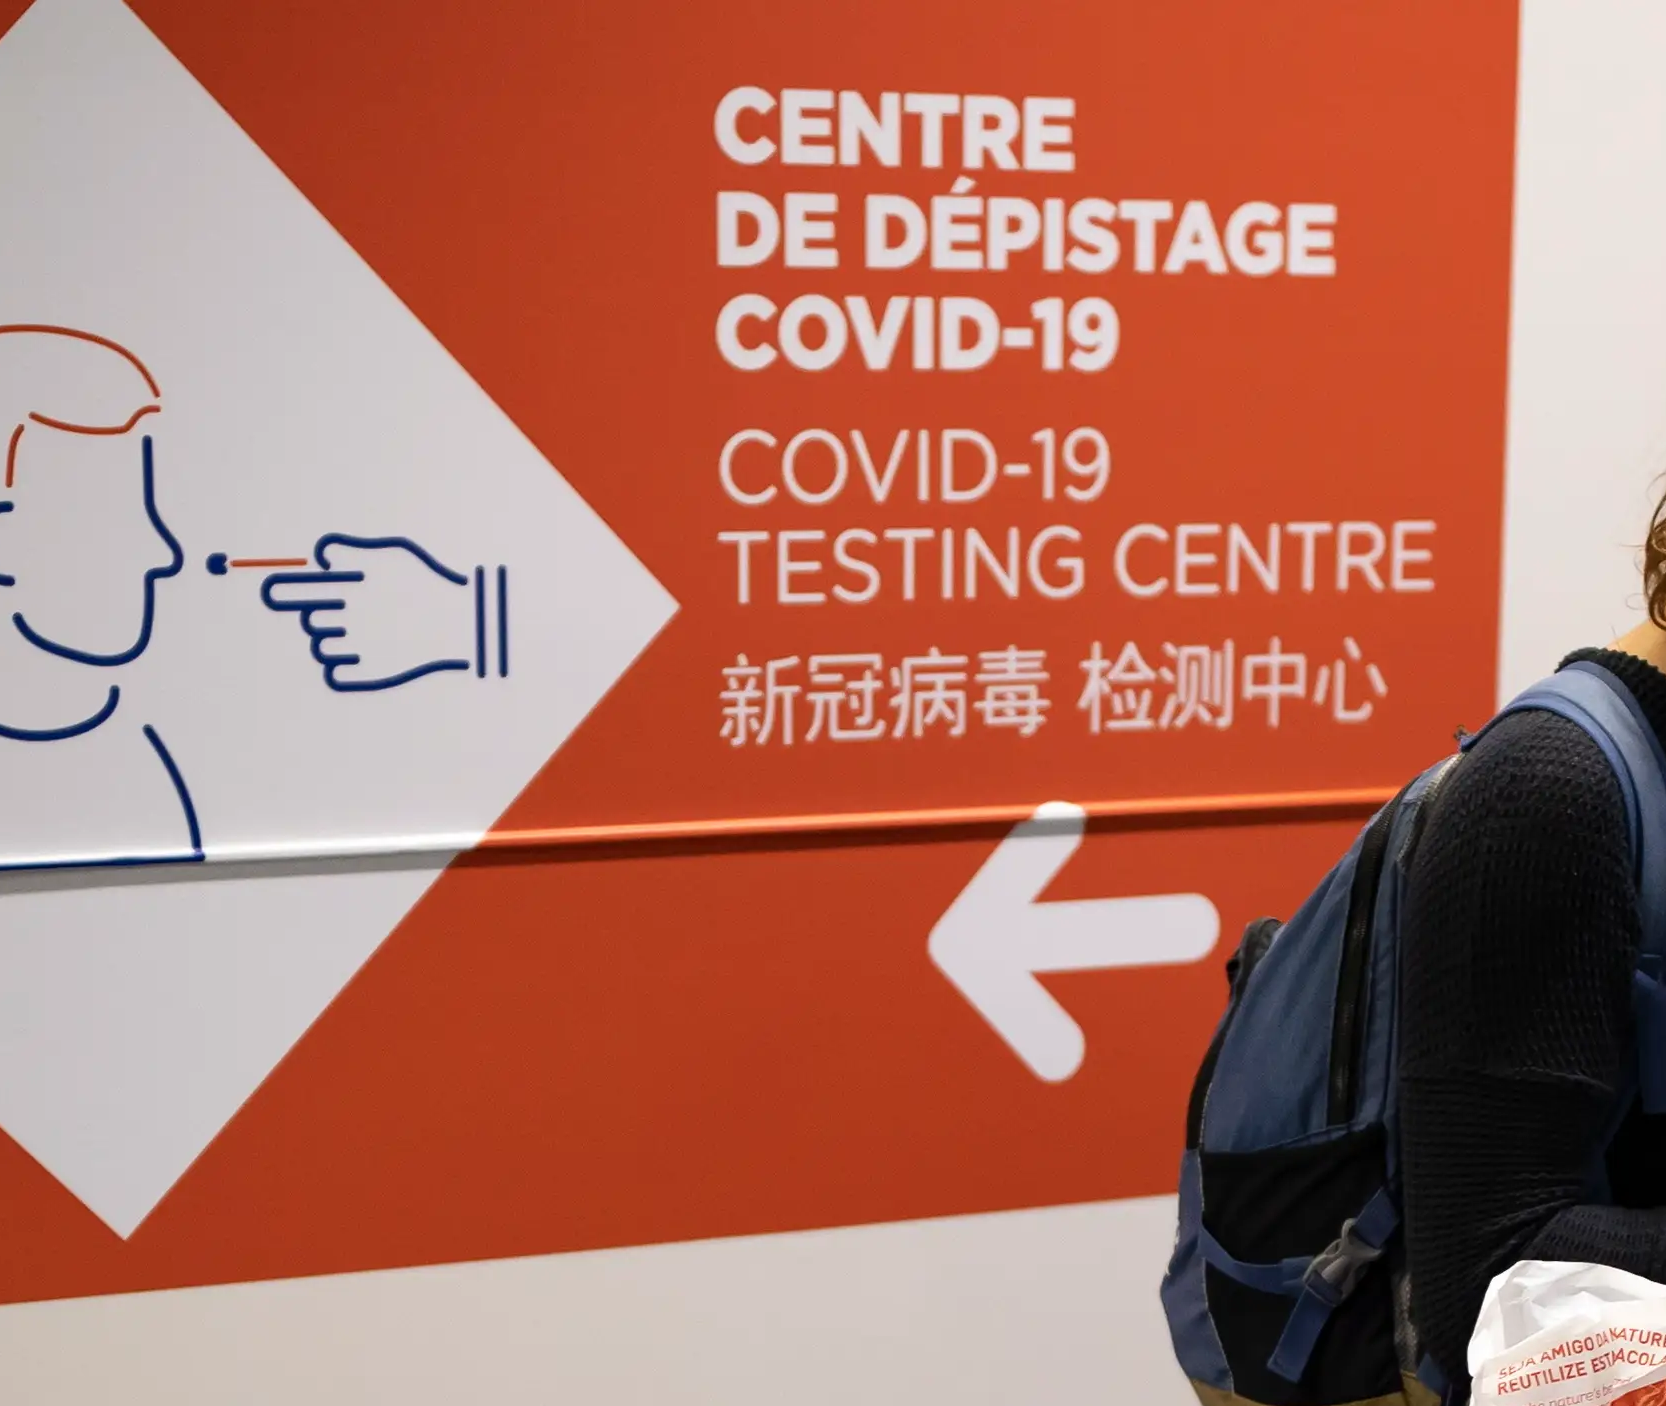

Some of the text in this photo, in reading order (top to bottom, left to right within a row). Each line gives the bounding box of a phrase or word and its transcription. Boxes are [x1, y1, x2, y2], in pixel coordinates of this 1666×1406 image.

[715, 86, 1075, 171] CENTRE
[716, 176, 1338, 276] DE DÉPISTAGE
[715, 294, 1120, 372] COVID-19
[719, 427, 1112, 505] COVID-19
[717, 520, 1437, 605] TESTING CENTRE
[719, 637, 1387, 747] 新冠病毒 检测中心
[1497, 1360, 1588, 1396] REUTILIZE
[1498, 1357, 1536, 1380] SEJA
[1540, 1336, 1595, 1364] AMIGO
[1595, 1330, 1610, 1348] DA
